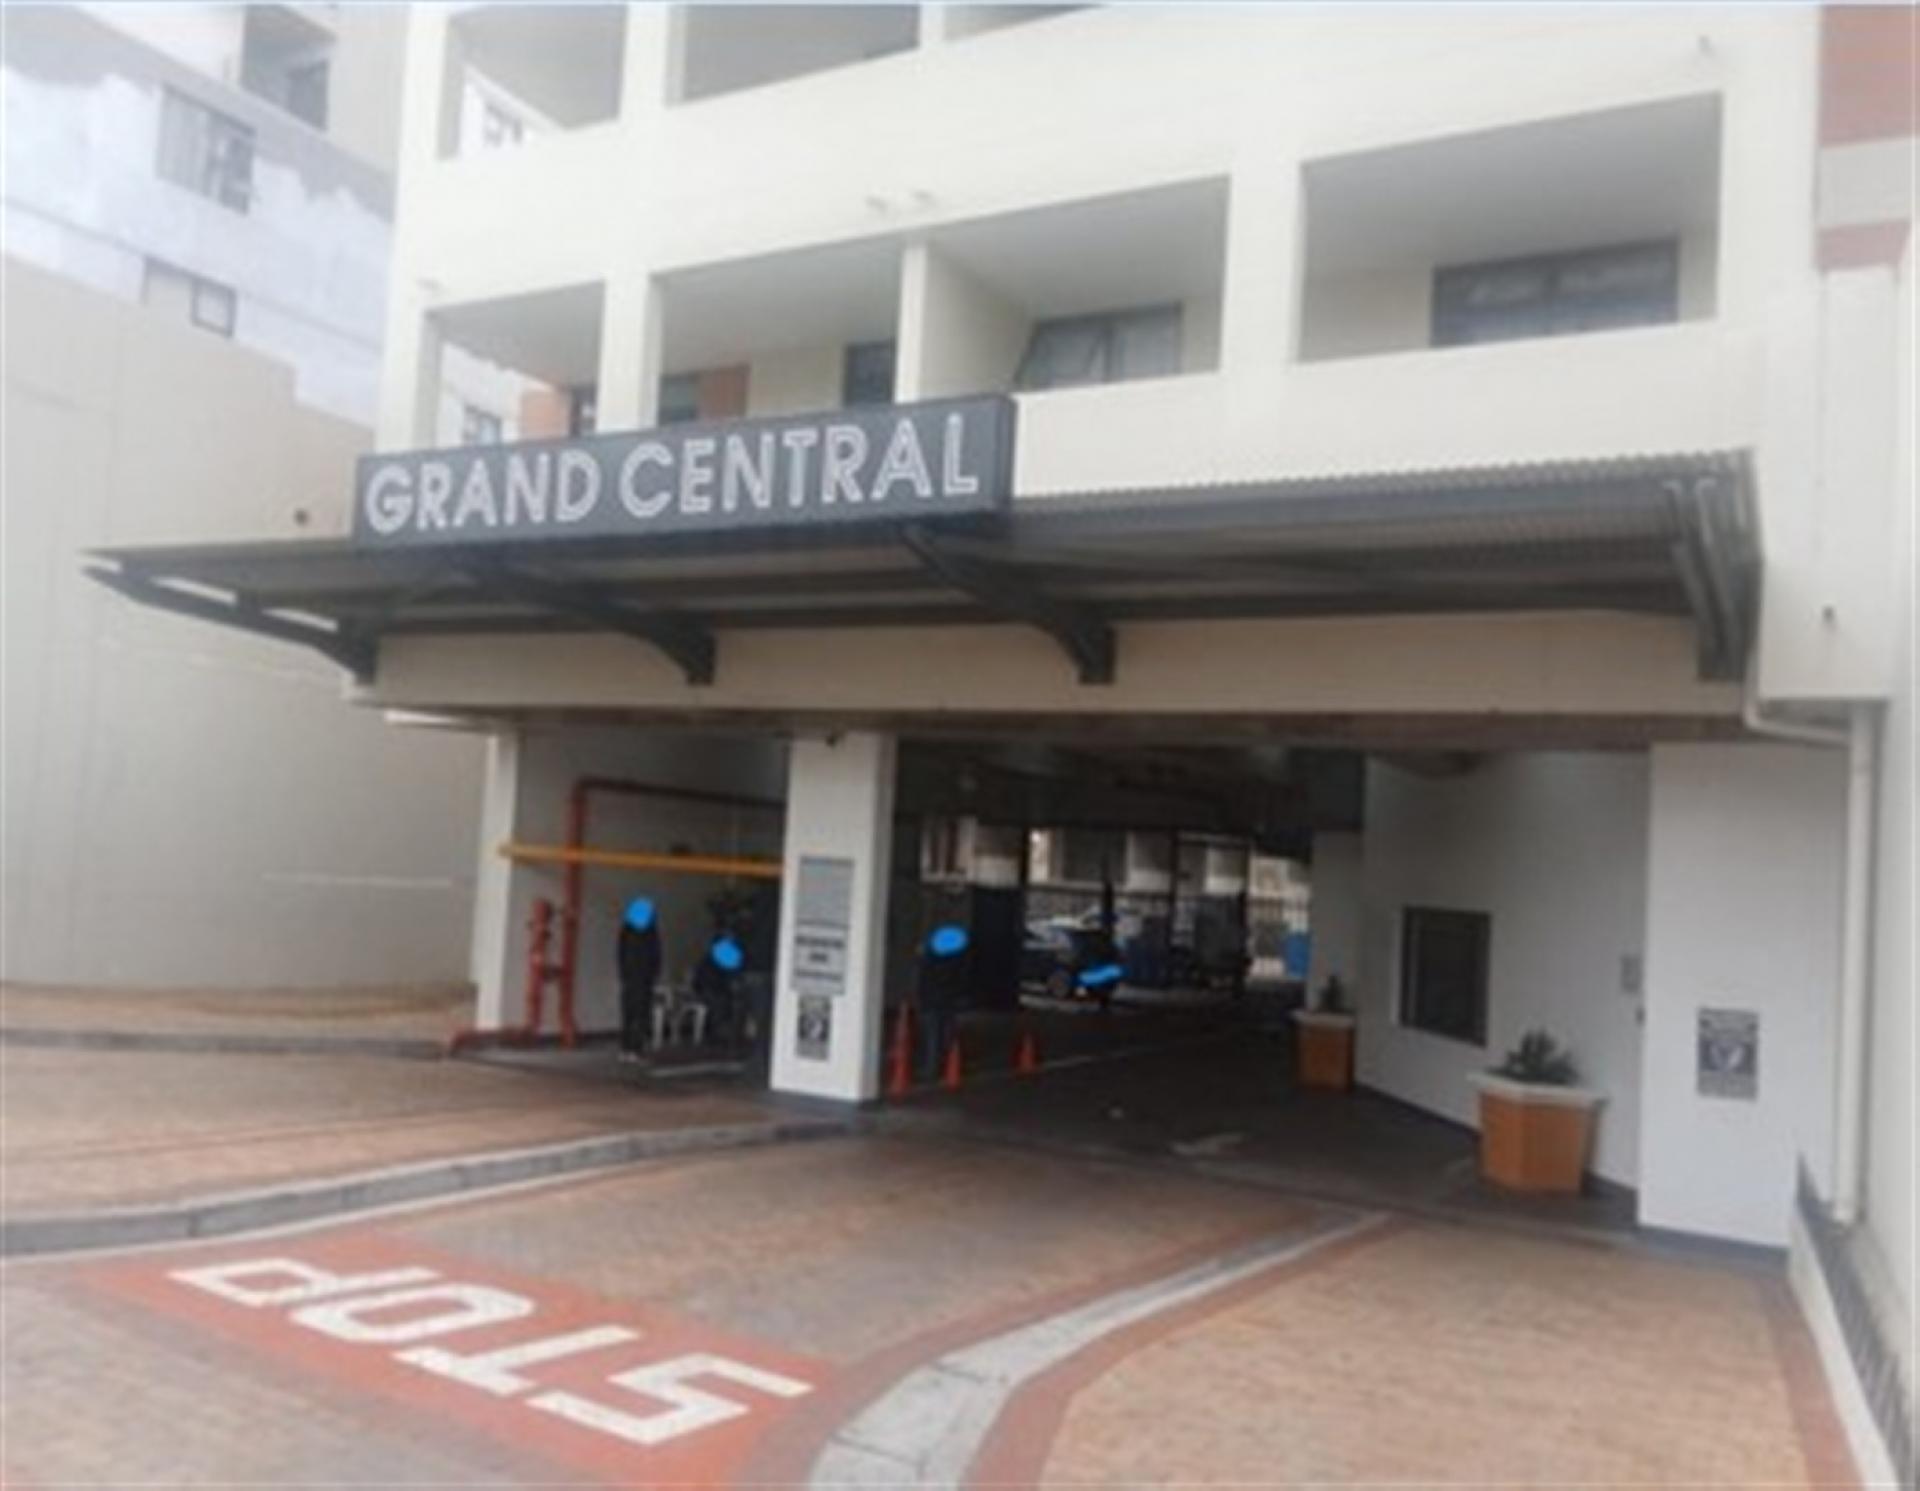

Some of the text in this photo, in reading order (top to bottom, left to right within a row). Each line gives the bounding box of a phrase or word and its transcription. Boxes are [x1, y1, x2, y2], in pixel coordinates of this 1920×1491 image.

[365, 412, 980, 534] GRAND CENTRAL
[166, 1257, 814, 1447] STOP
